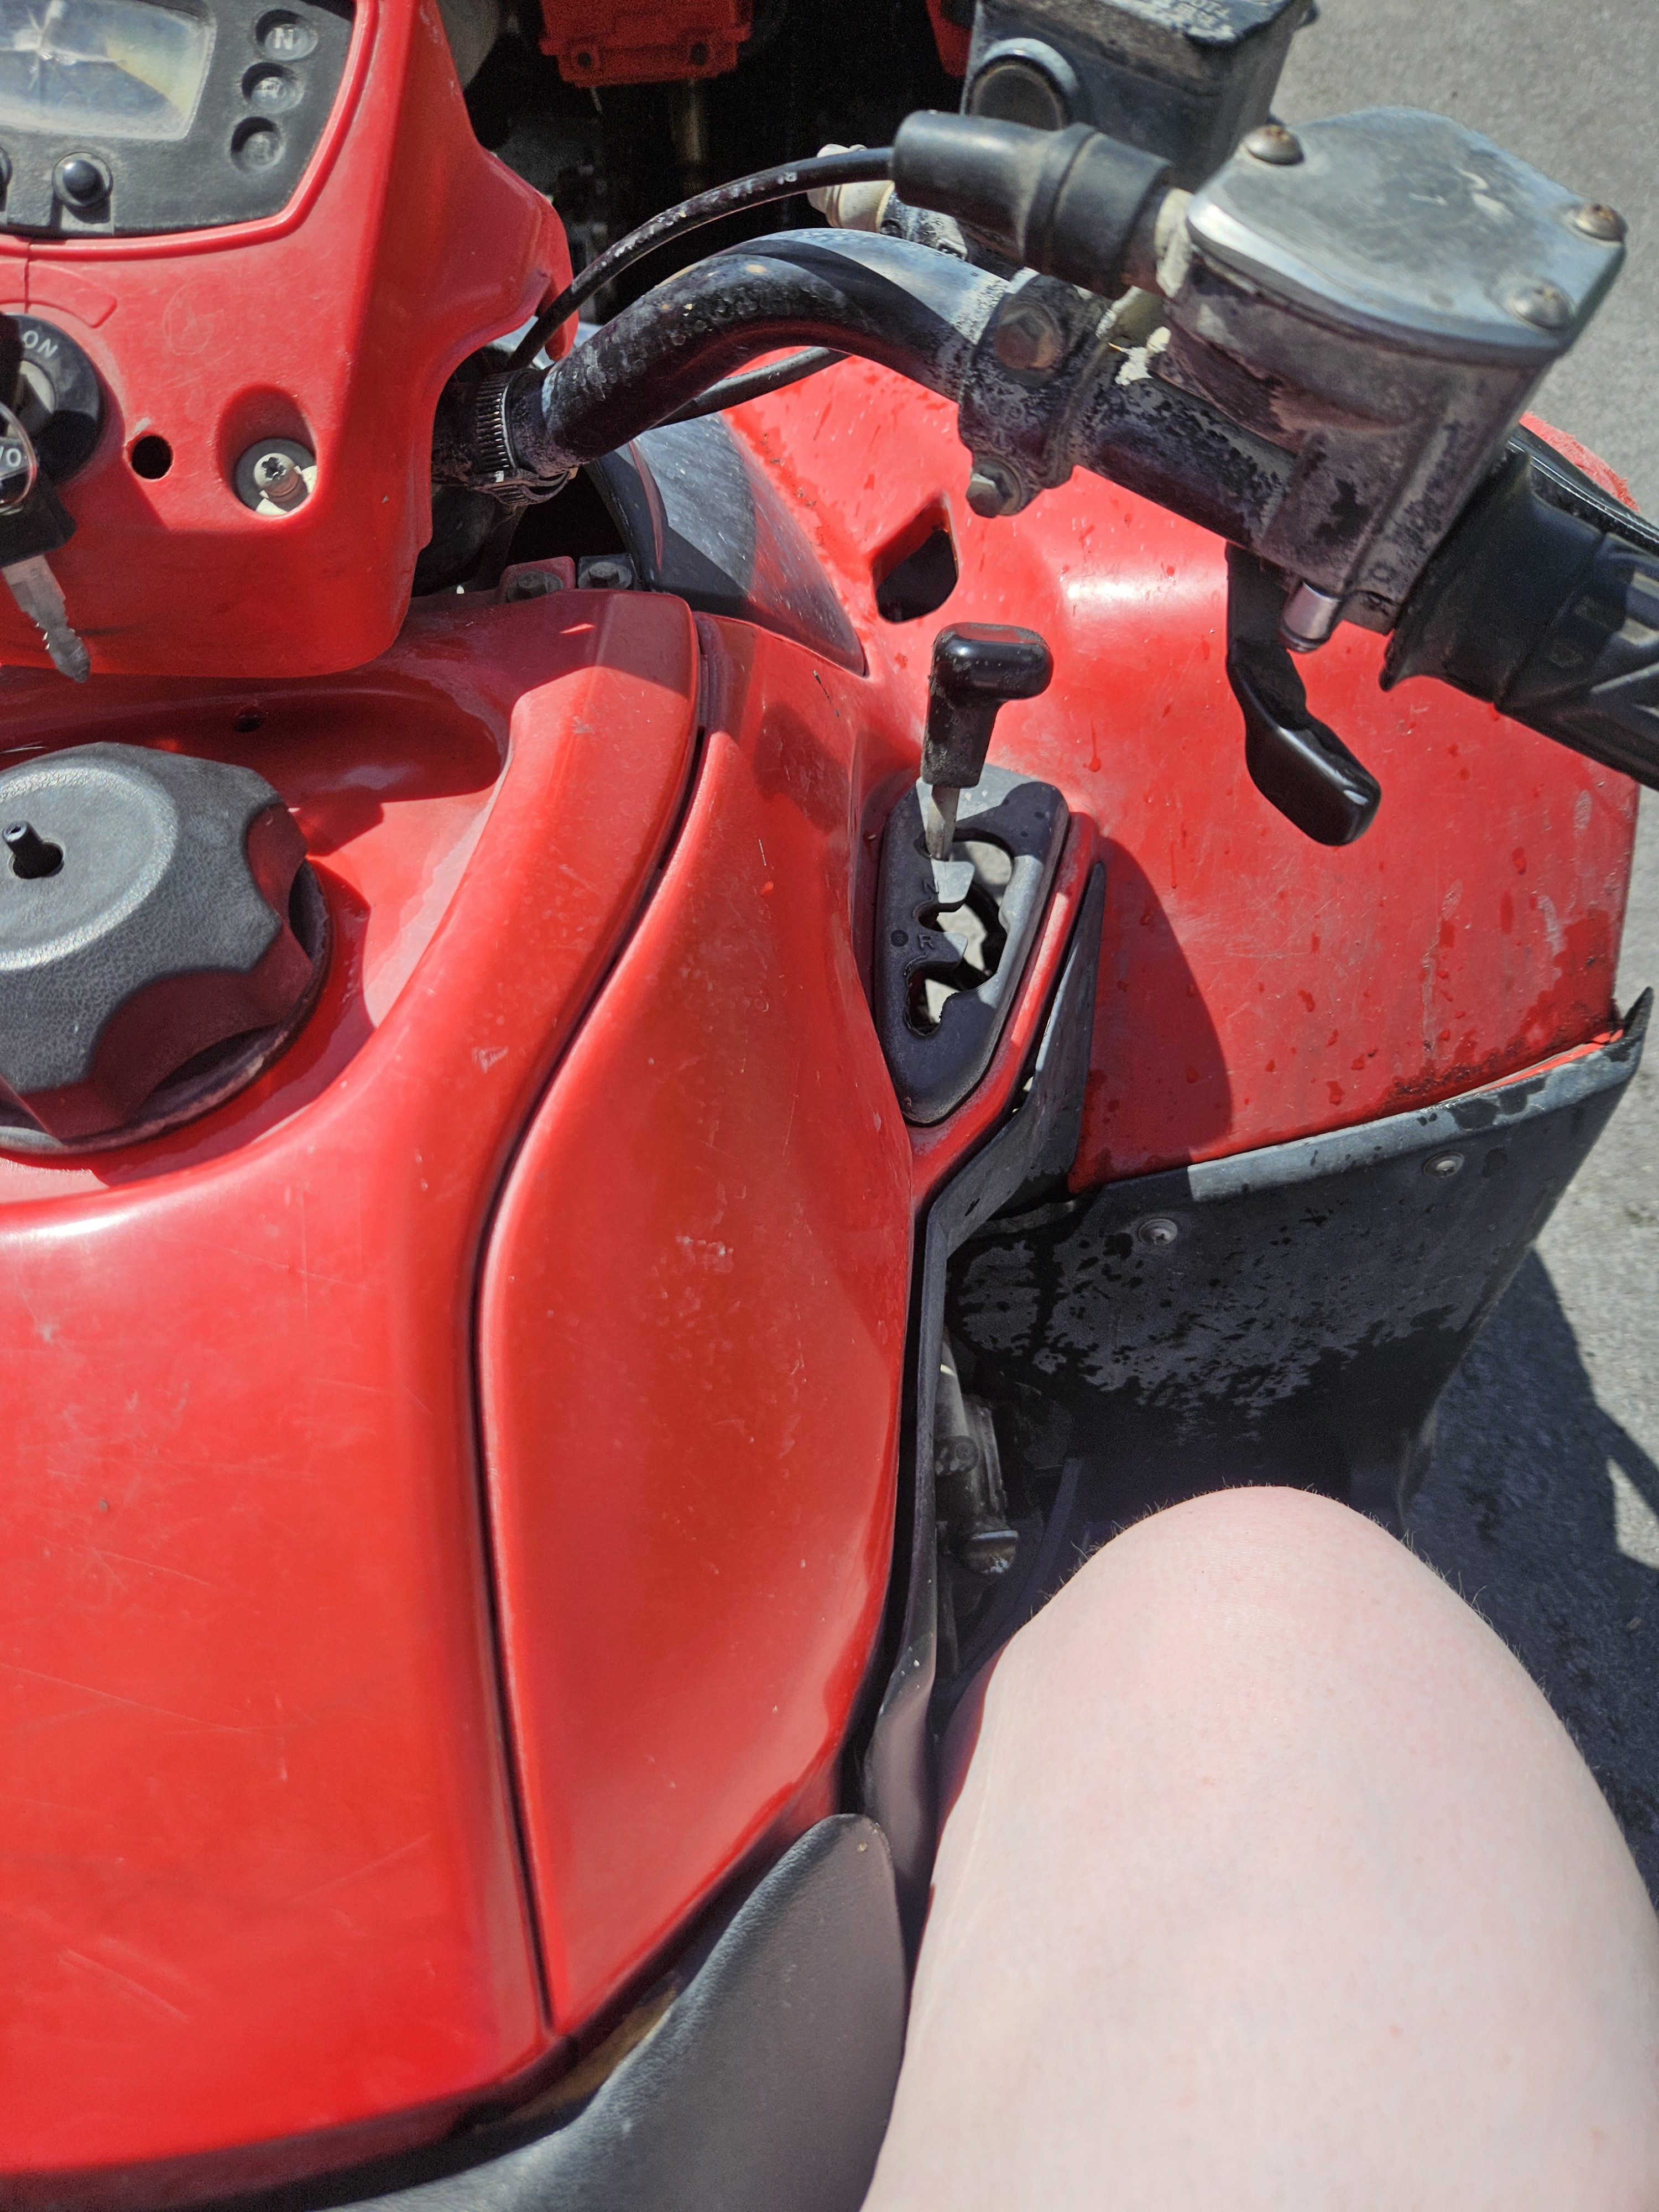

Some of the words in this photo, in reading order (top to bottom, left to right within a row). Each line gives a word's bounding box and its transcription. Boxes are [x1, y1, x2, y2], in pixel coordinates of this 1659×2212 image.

[274, 27, 294, 50] N
[23, 330, 58, 358] ON
[917, 933, 935, 950] R
